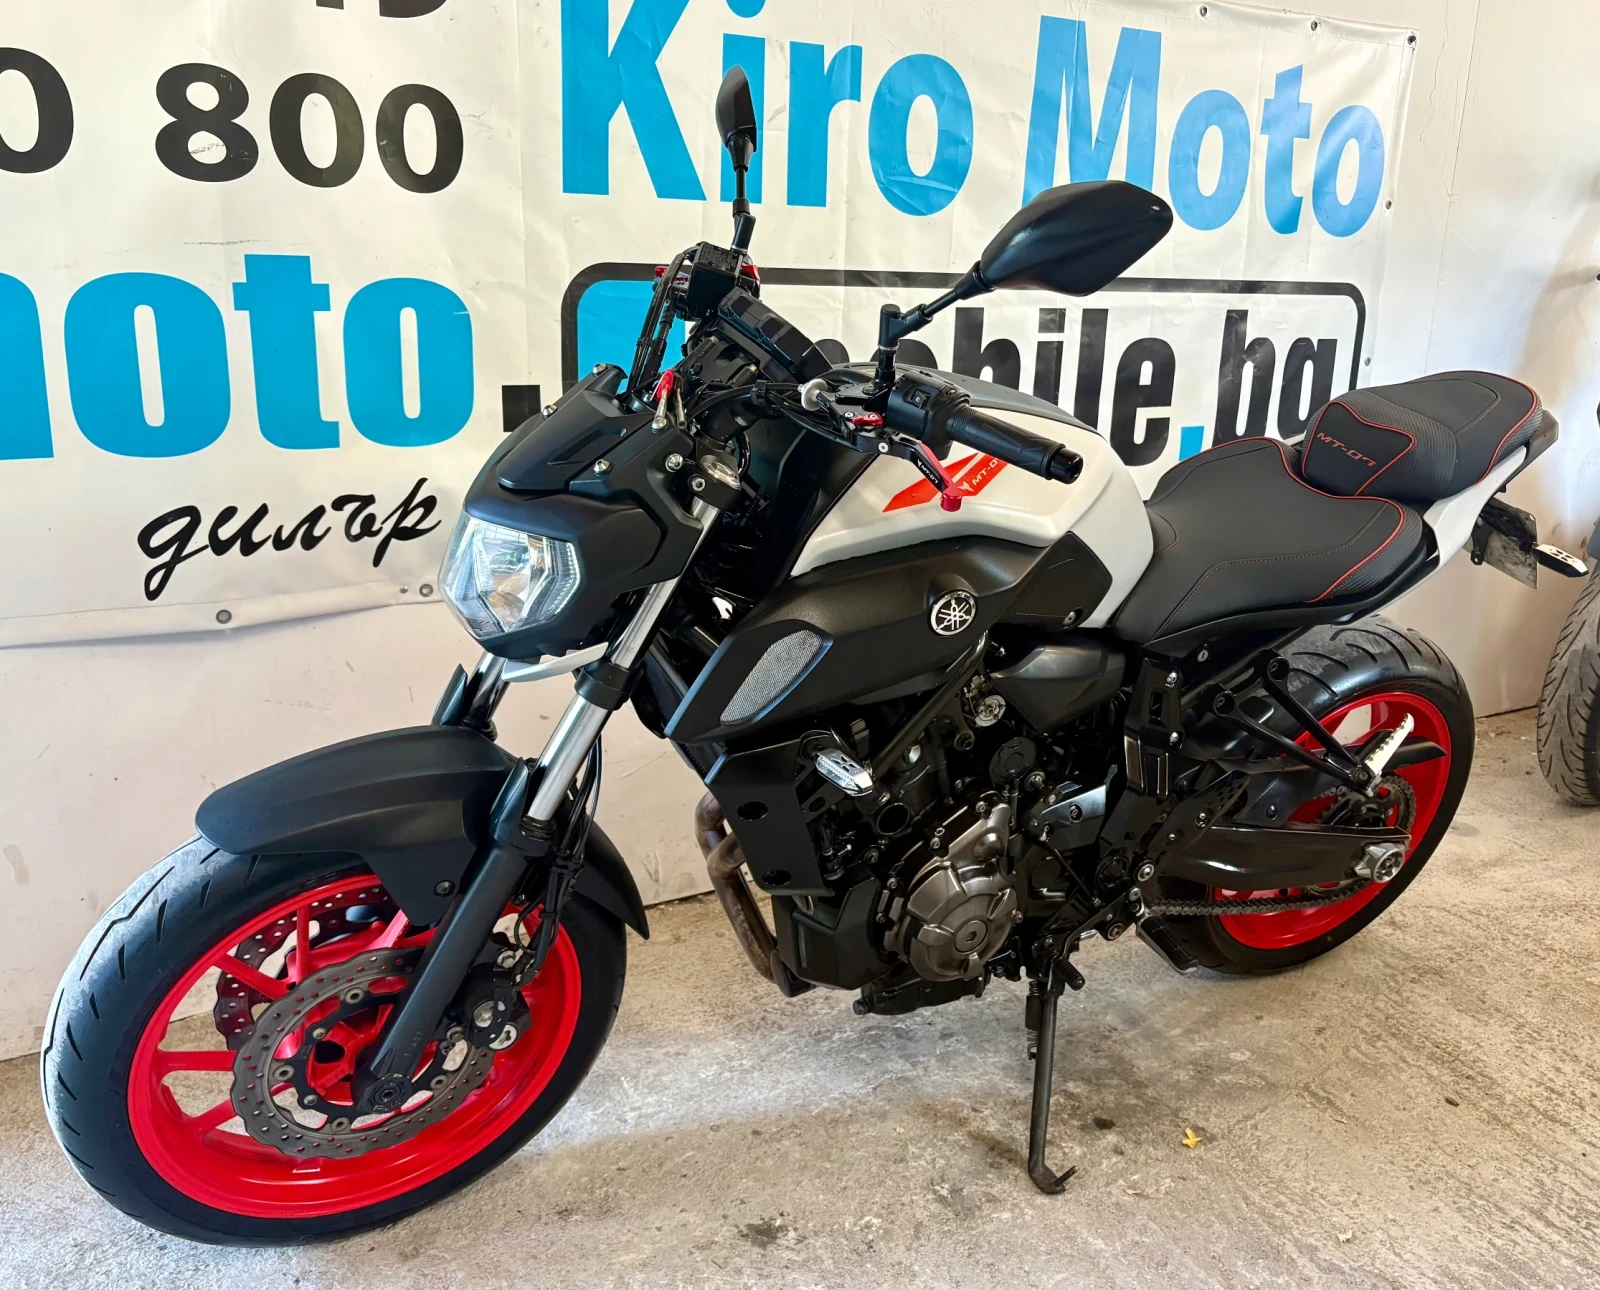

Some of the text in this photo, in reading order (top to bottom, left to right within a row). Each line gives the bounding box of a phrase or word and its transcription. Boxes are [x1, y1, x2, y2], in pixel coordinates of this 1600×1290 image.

[155, 62, 464, 194] 800
[562, 0, 1385, 238] Kiro Moto
[0, 253, 541, 460] oto.
[971, 457, 998, 486] MT-0
[1316, 432, 1377, 468] MT-07
[137, 477, 441, 601] дилър
